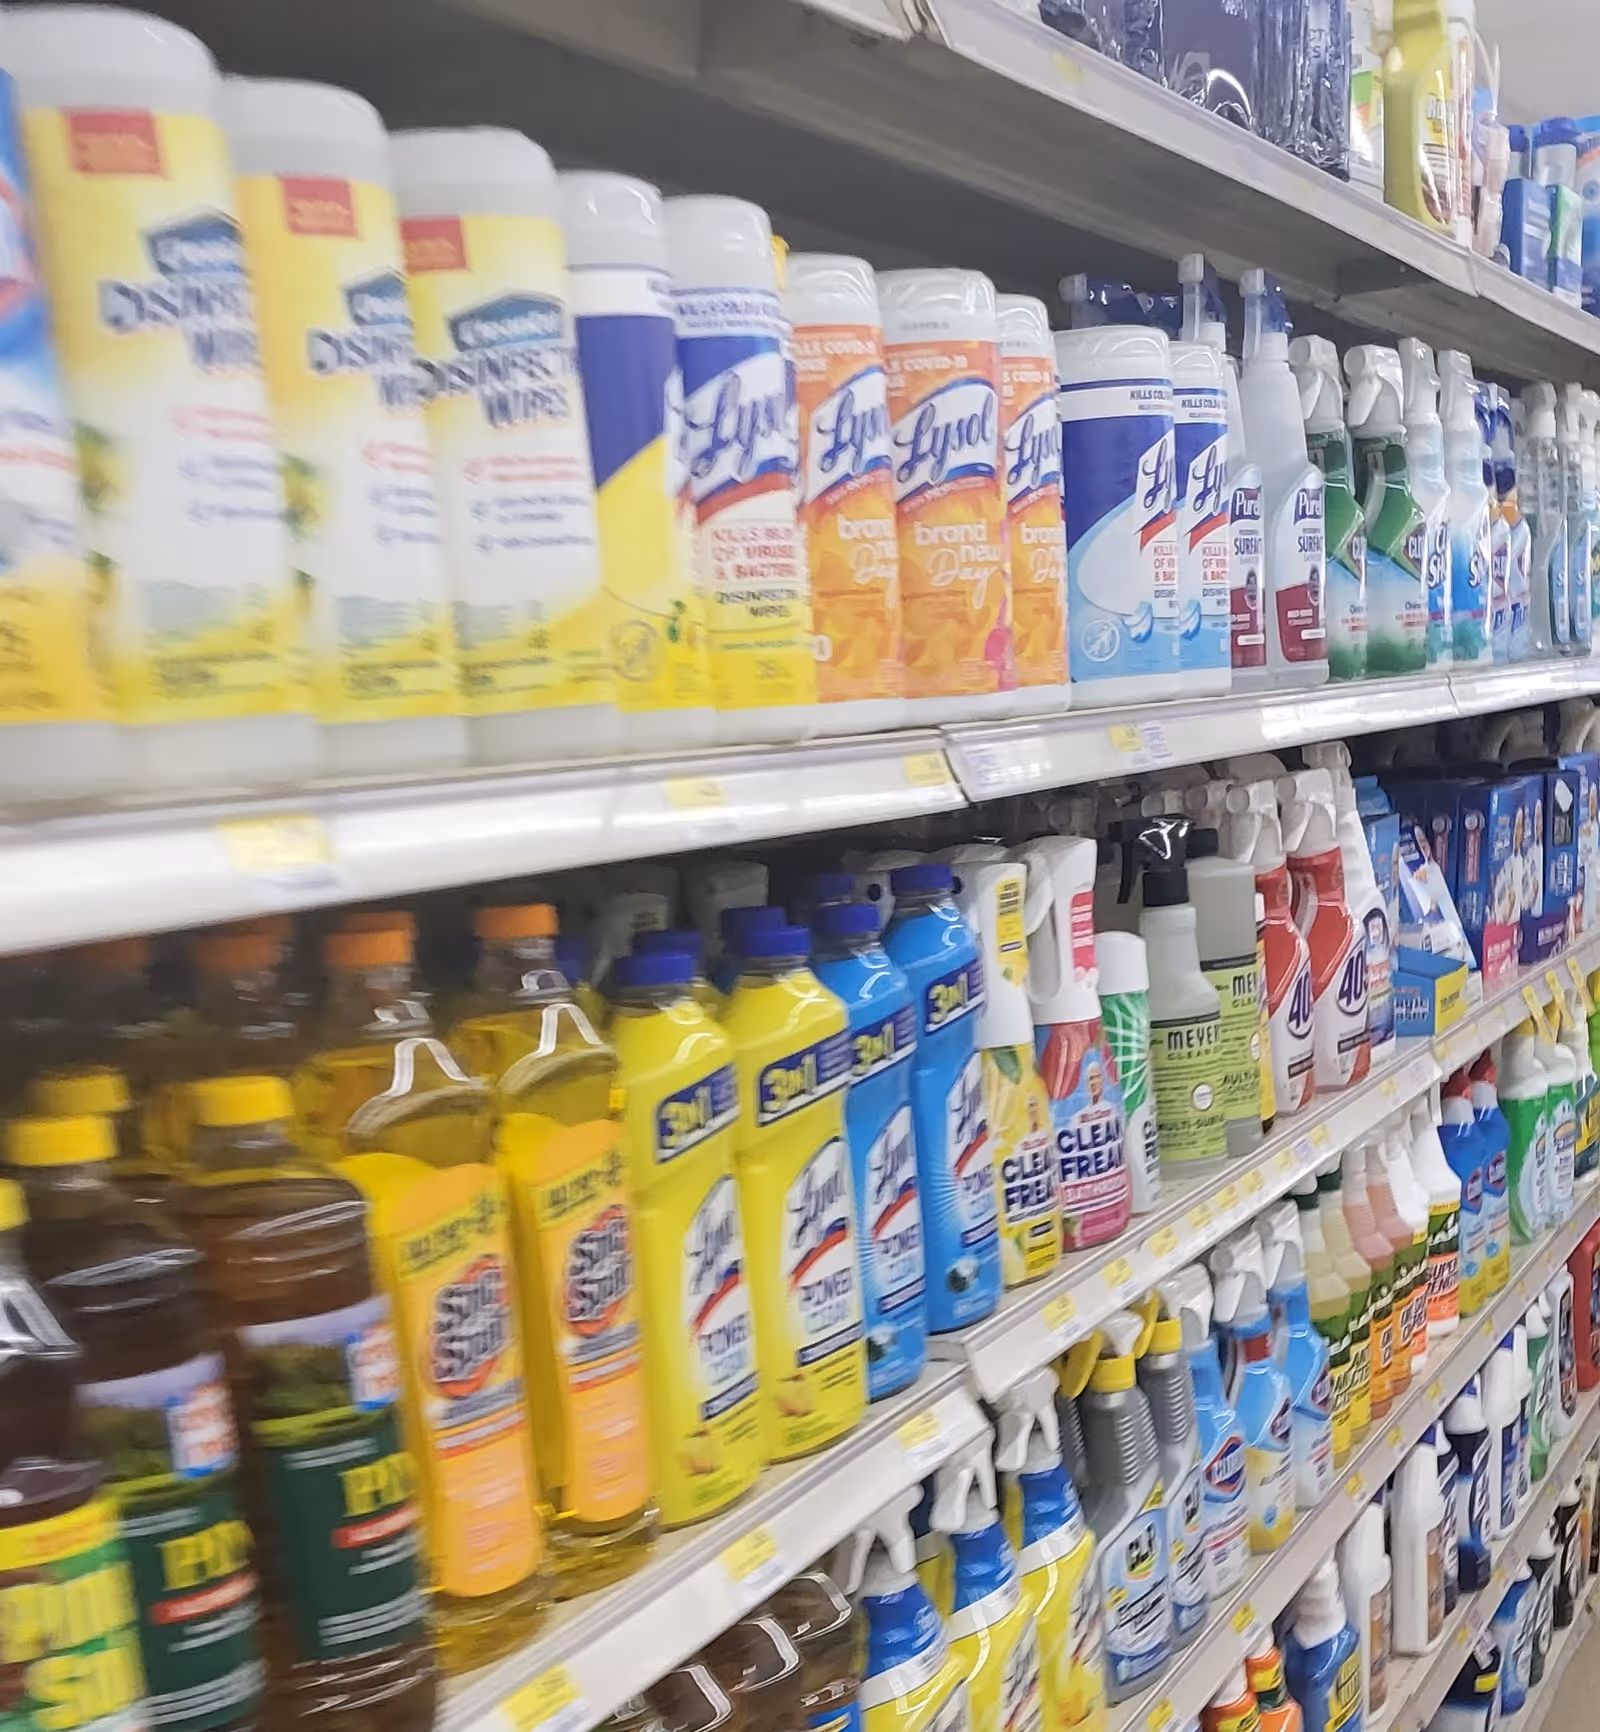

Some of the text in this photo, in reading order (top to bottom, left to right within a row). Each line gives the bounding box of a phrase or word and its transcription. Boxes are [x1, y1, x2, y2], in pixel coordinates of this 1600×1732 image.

[1182, 399, 1203, 409] KILLS
[893, 392, 993, 483] Lysol
[914, 521, 987, 545] brand
[960, 544, 1002, 562] new
[1338, 949, 1368, 1008] 40
[1289, 970, 1311, 1030] 40
